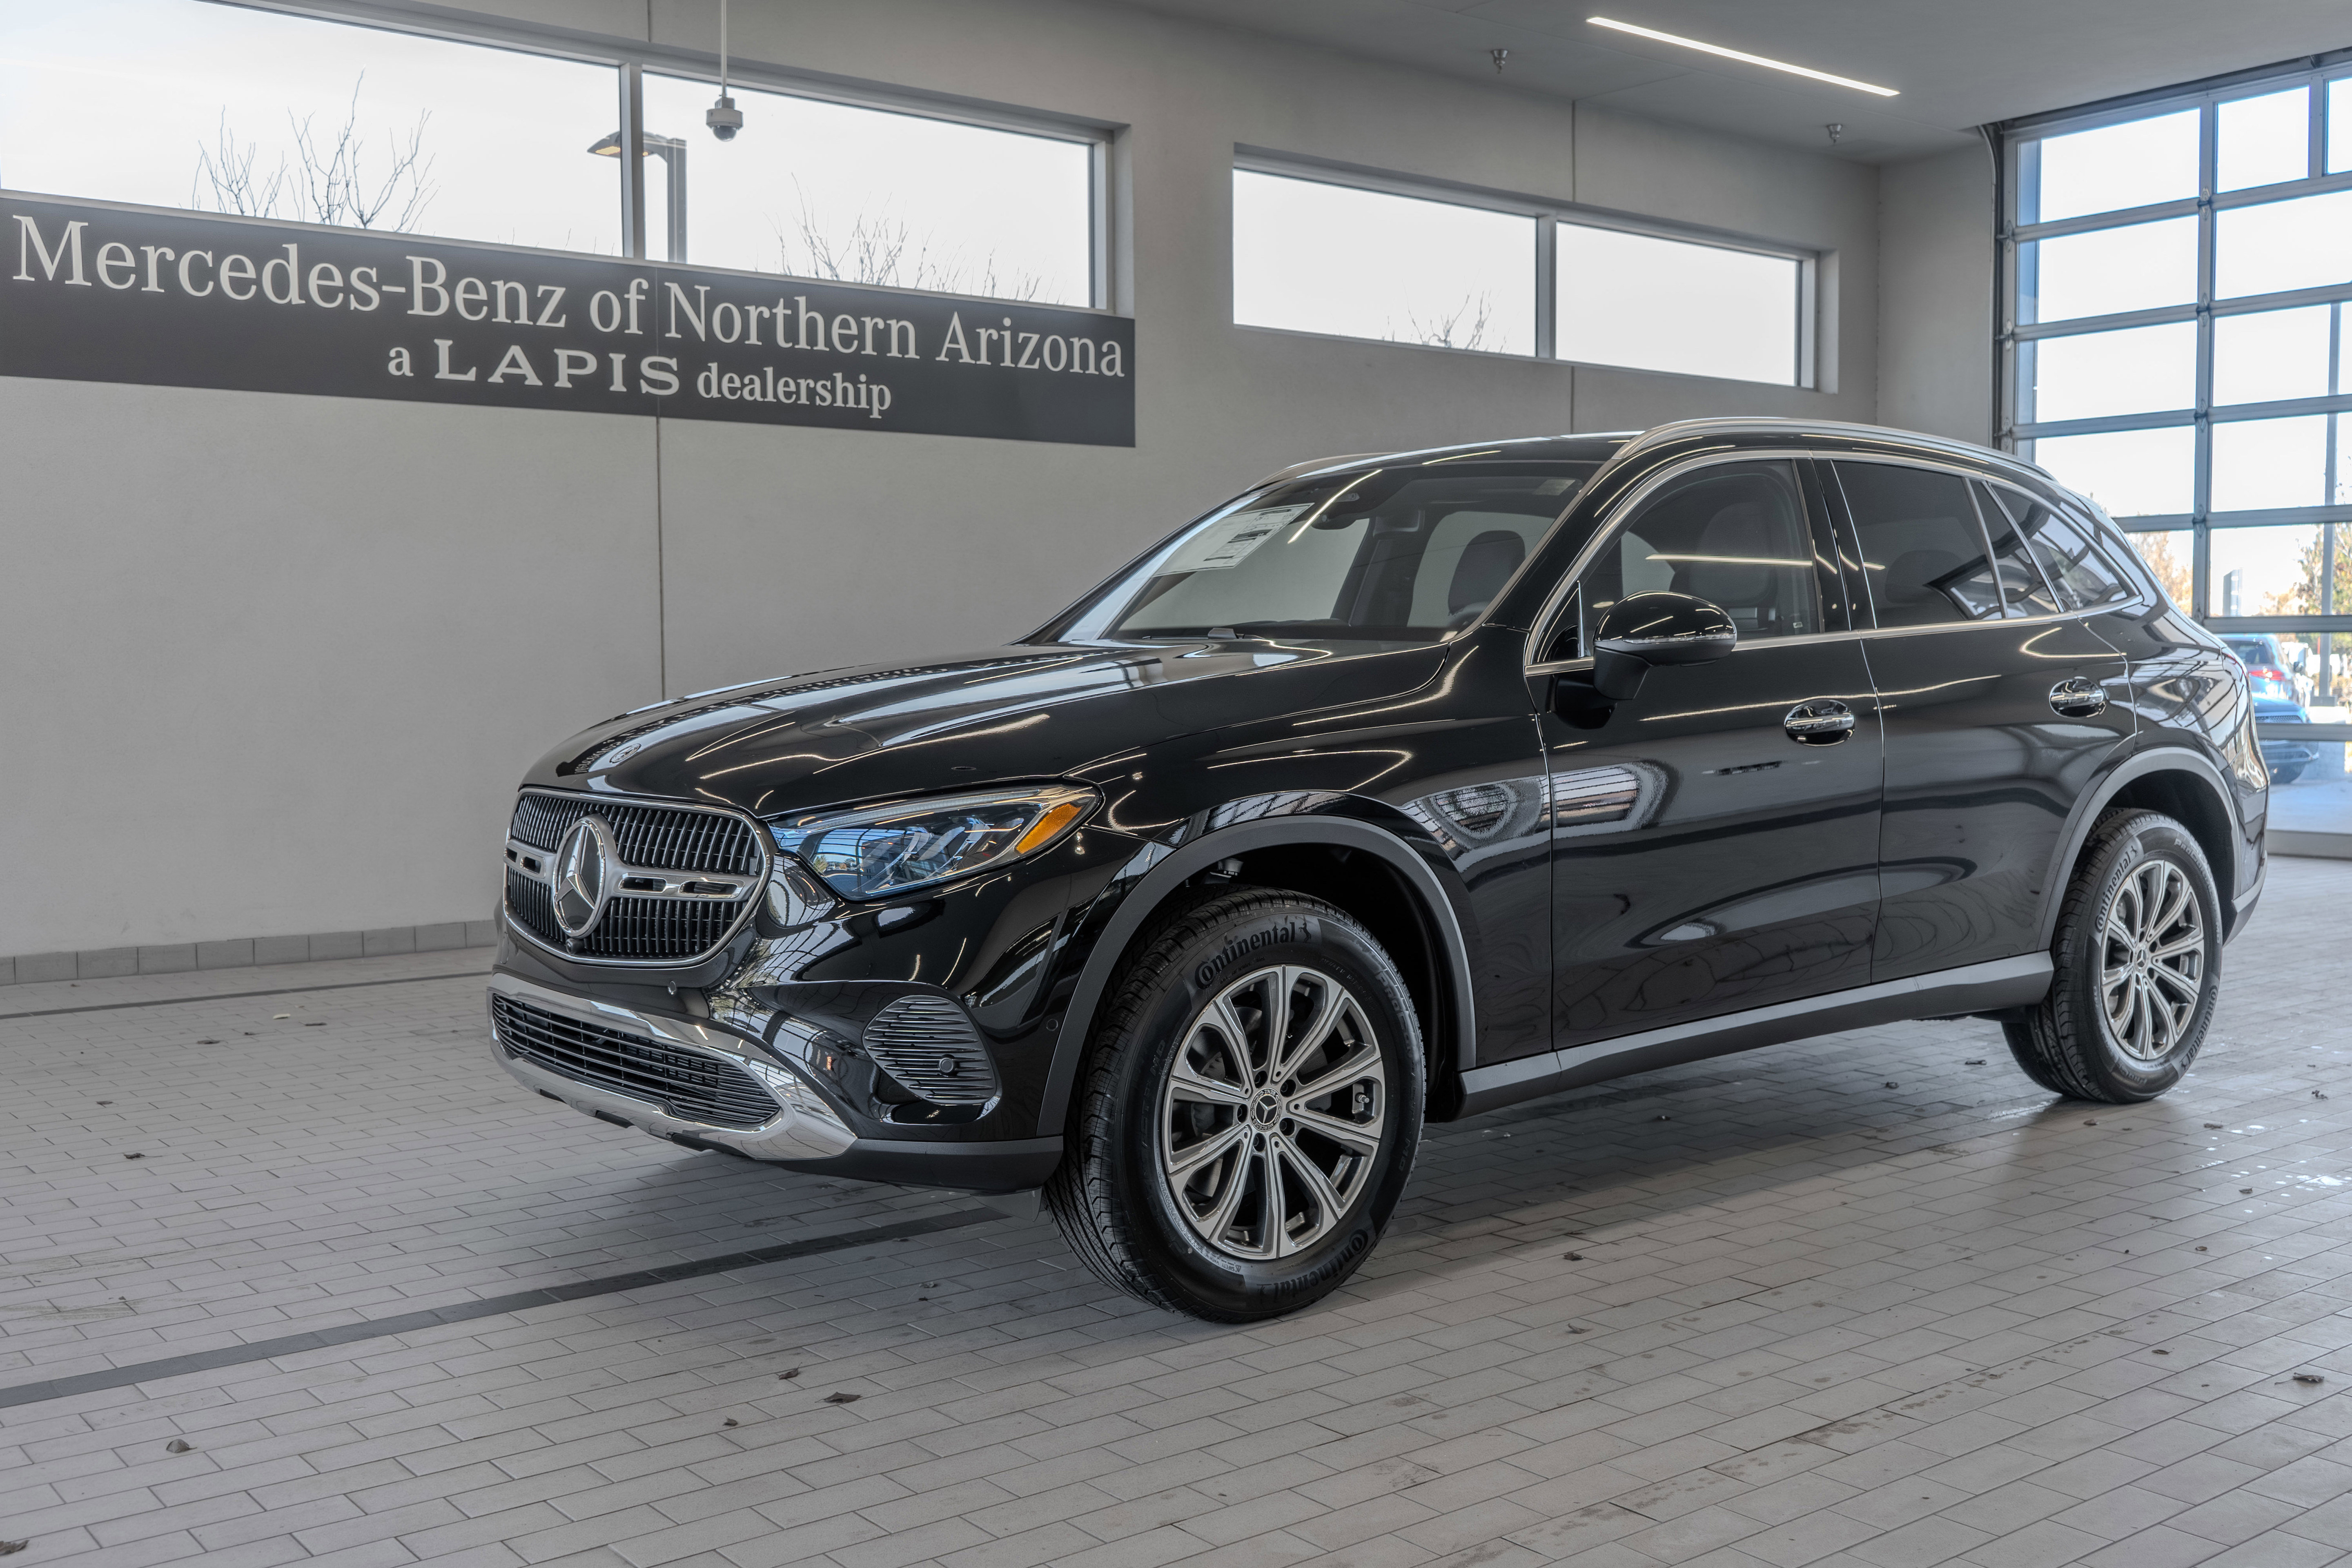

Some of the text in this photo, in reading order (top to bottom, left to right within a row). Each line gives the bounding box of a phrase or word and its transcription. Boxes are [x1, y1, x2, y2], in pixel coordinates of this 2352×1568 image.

[11, 211, 1124, 376] Mercedes-Benz of Northern Arizona
[388, 339, 891, 418] a LAPIS dealership
[2095, 851, 2131, 932] Continental
[1195, 922, 1295, 990] Continental
[2186, 985, 2218, 1063] Continental
[1252, 1119, 1274, 1130] MERCEDES
[1273, 1229, 1368, 1303] Continental
